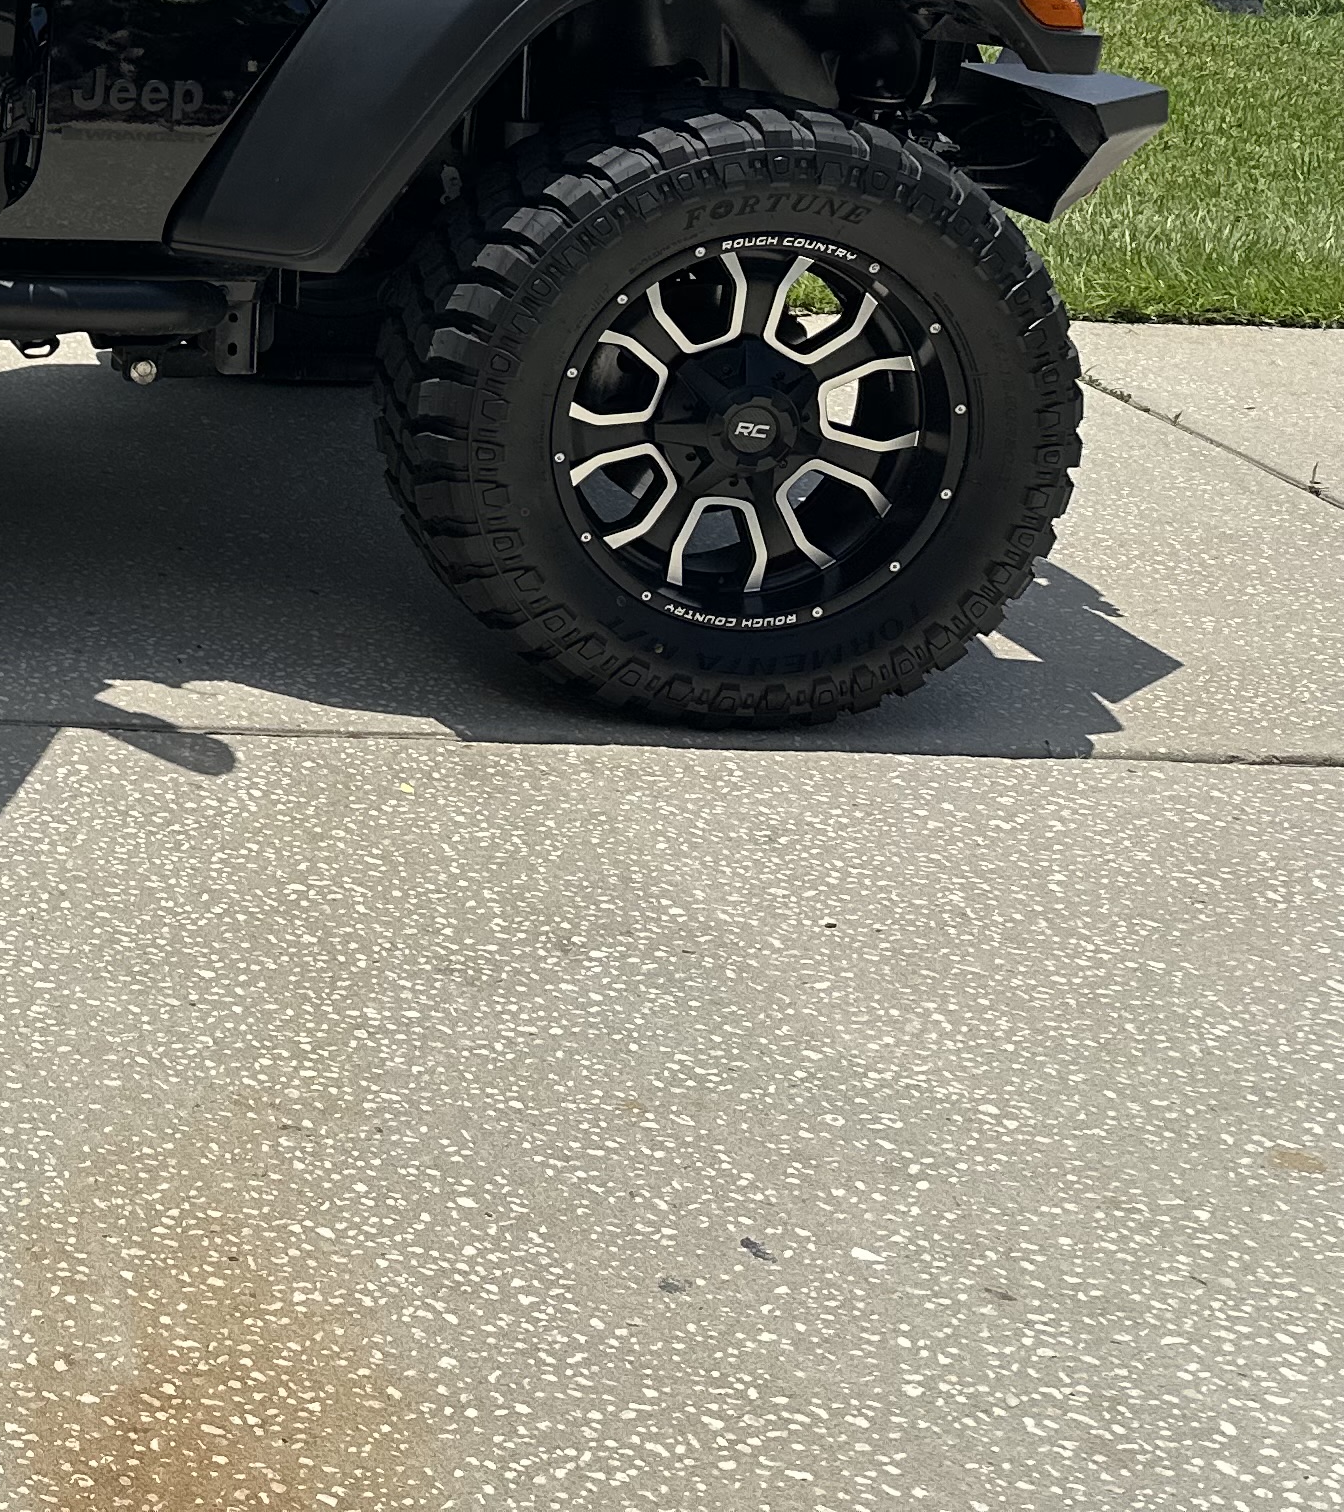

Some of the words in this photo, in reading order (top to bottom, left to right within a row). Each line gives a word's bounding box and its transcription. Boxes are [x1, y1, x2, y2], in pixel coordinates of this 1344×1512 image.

[72, 67, 205, 121] Jeep
[682, 192, 873, 231] FORTUNE
[721, 237, 778, 251] ROUGH
[782, 237, 858, 261] COUNTRY
[734, 422, 771, 439] RC
[664, 603, 737, 627] COUNTRY
[741, 614, 797, 628] ROUGH
